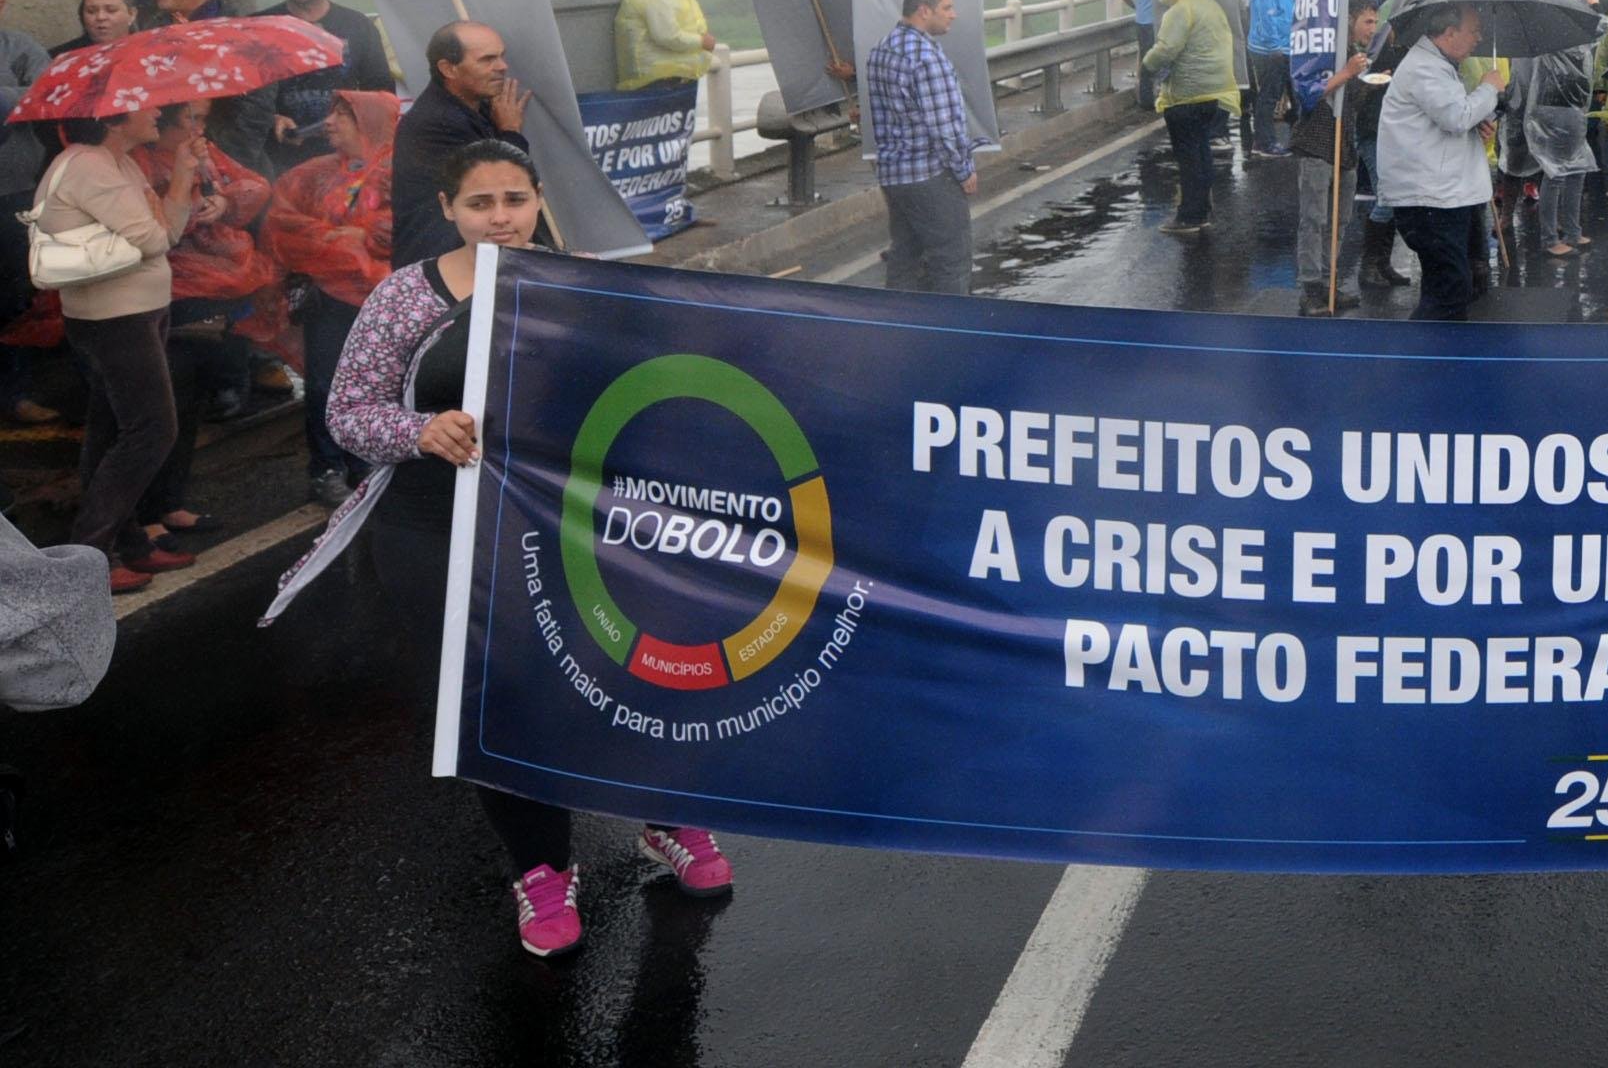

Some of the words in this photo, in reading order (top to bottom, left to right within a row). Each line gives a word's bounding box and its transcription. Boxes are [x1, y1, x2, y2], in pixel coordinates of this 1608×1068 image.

[621, 112, 683, 142] UNIDOS
[617, 144, 655, 171] POR
[913, 401, 1313, 501] PREFEITOS
[612, 475, 782, 523] #MOVIMENTO
[602, 506, 786, 567] DOBOLO
[968, 509, 1021, 582] A
[1044, 515, 1266, 600] CRISE
[1292, 532, 1336, 603] E
[1365, 534, 1523, 606] POR
[521, 531, 543, 596] Uma
[533, 599, 564, 656] fatia
[559, 653, 613, 712] maior
[612, 704, 665, 739] para
[672, 721, 709, 742] um
[716, 668, 821, 739] município
[818, 580, 874, 670] melhor.
[592, 604, 621, 642] UNIÃO
[738, 612, 788, 662] ESTADOS
[640, 652, 713, 676] MUNICÍPIOS
[1064, 618, 1307, 703] PACTO
